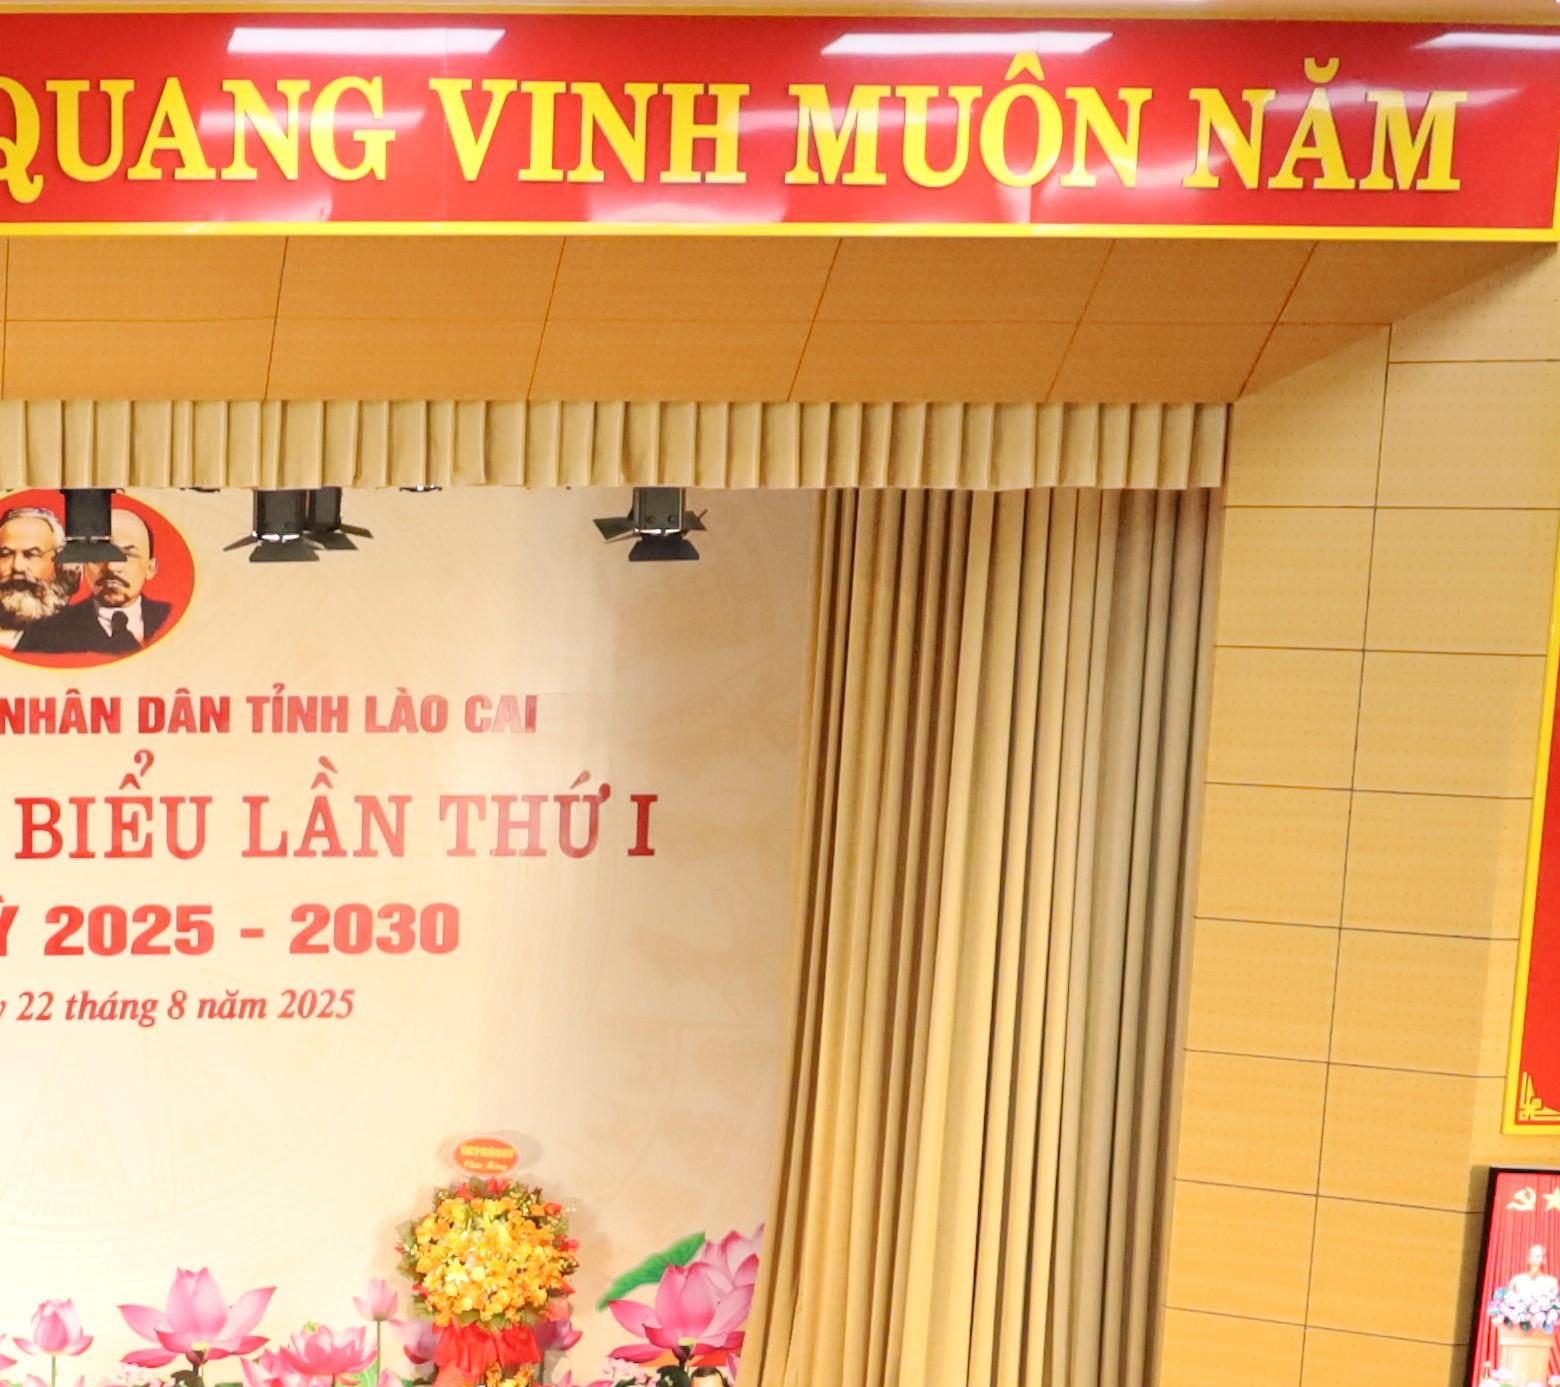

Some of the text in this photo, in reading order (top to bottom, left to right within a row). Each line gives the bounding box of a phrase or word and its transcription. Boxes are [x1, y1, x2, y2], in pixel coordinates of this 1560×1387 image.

[430, 78, 749, 184] VINH
[785, 51, 1152, 189] MUÔN
[1184, 57, 1468, 191] NĂM
[136, 686, 233, 736] DÂN
[244, 681, 351, 735] TỈNH
[363, 686, 450, 735] LÀO
[463, 693, 539, 735] CAI
[14, 747, 215, 861] BIỂU
[240, 755, 413, 859] LẦN
[439, 771, 614, 861] THỨ
[625, 791, 662, 859] I
[43, 903, 216, 958] 2025
[288, 901, 461, 956] 2030
[16, 990, 55, 1022] 22
[64, 990, 160, 1029] tháng
[167, 989, 188, 1020] 8
[197, 990, 268, 1021] năm
[278, 987, 355, 1020] 2025
